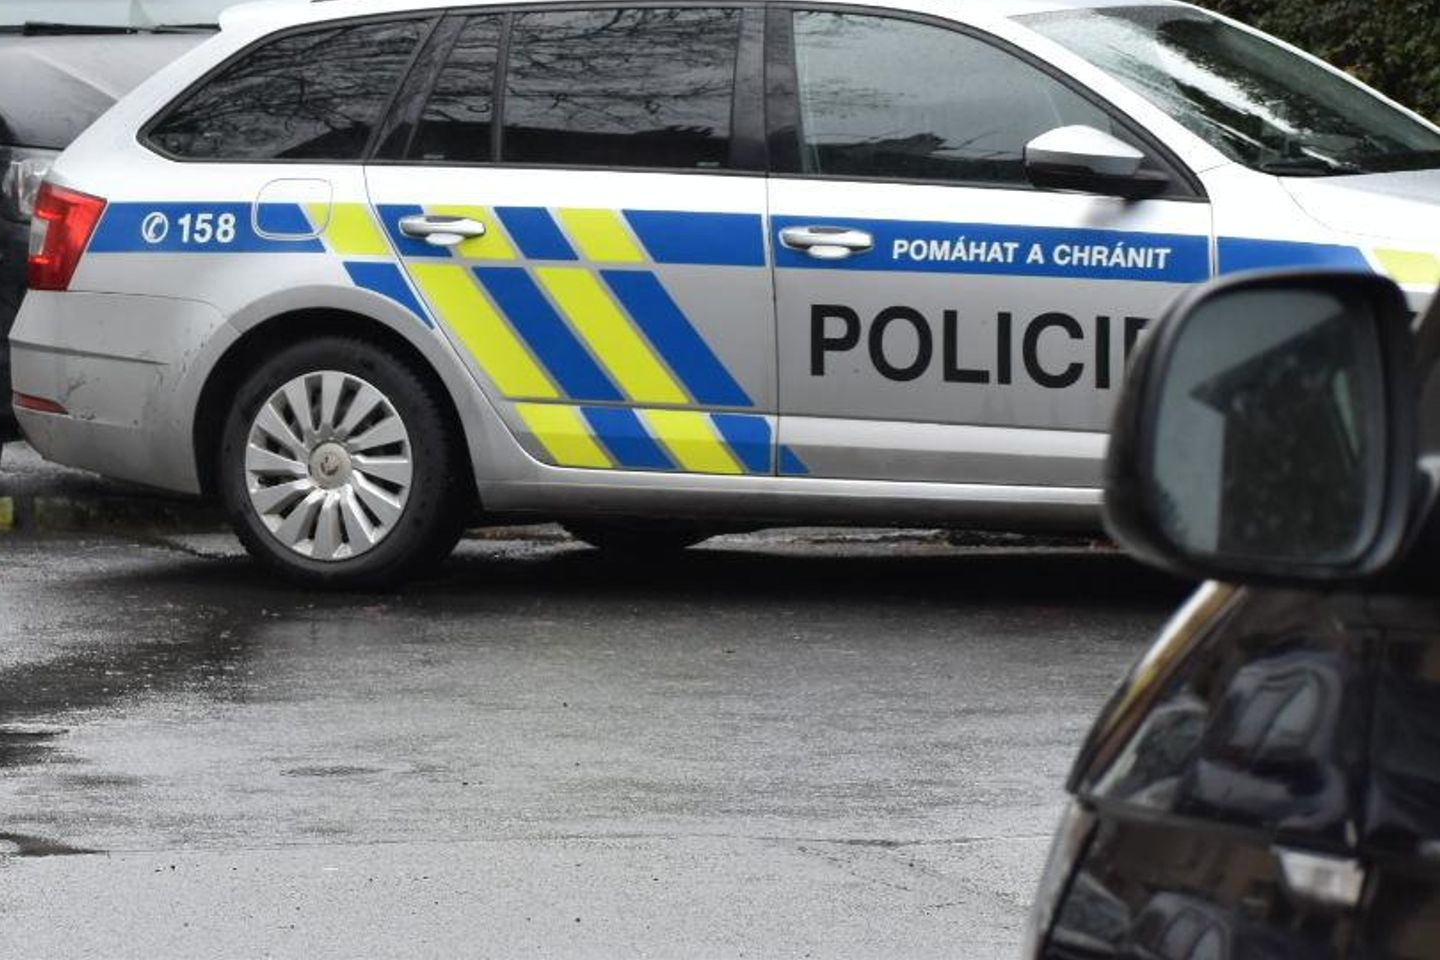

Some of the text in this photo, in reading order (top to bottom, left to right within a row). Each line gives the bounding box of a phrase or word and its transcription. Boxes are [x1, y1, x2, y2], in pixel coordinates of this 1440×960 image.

[178, 213, 236, 244] 158
[892, 236, 1171, 270] POMÁHAT A CHRÁNIT
